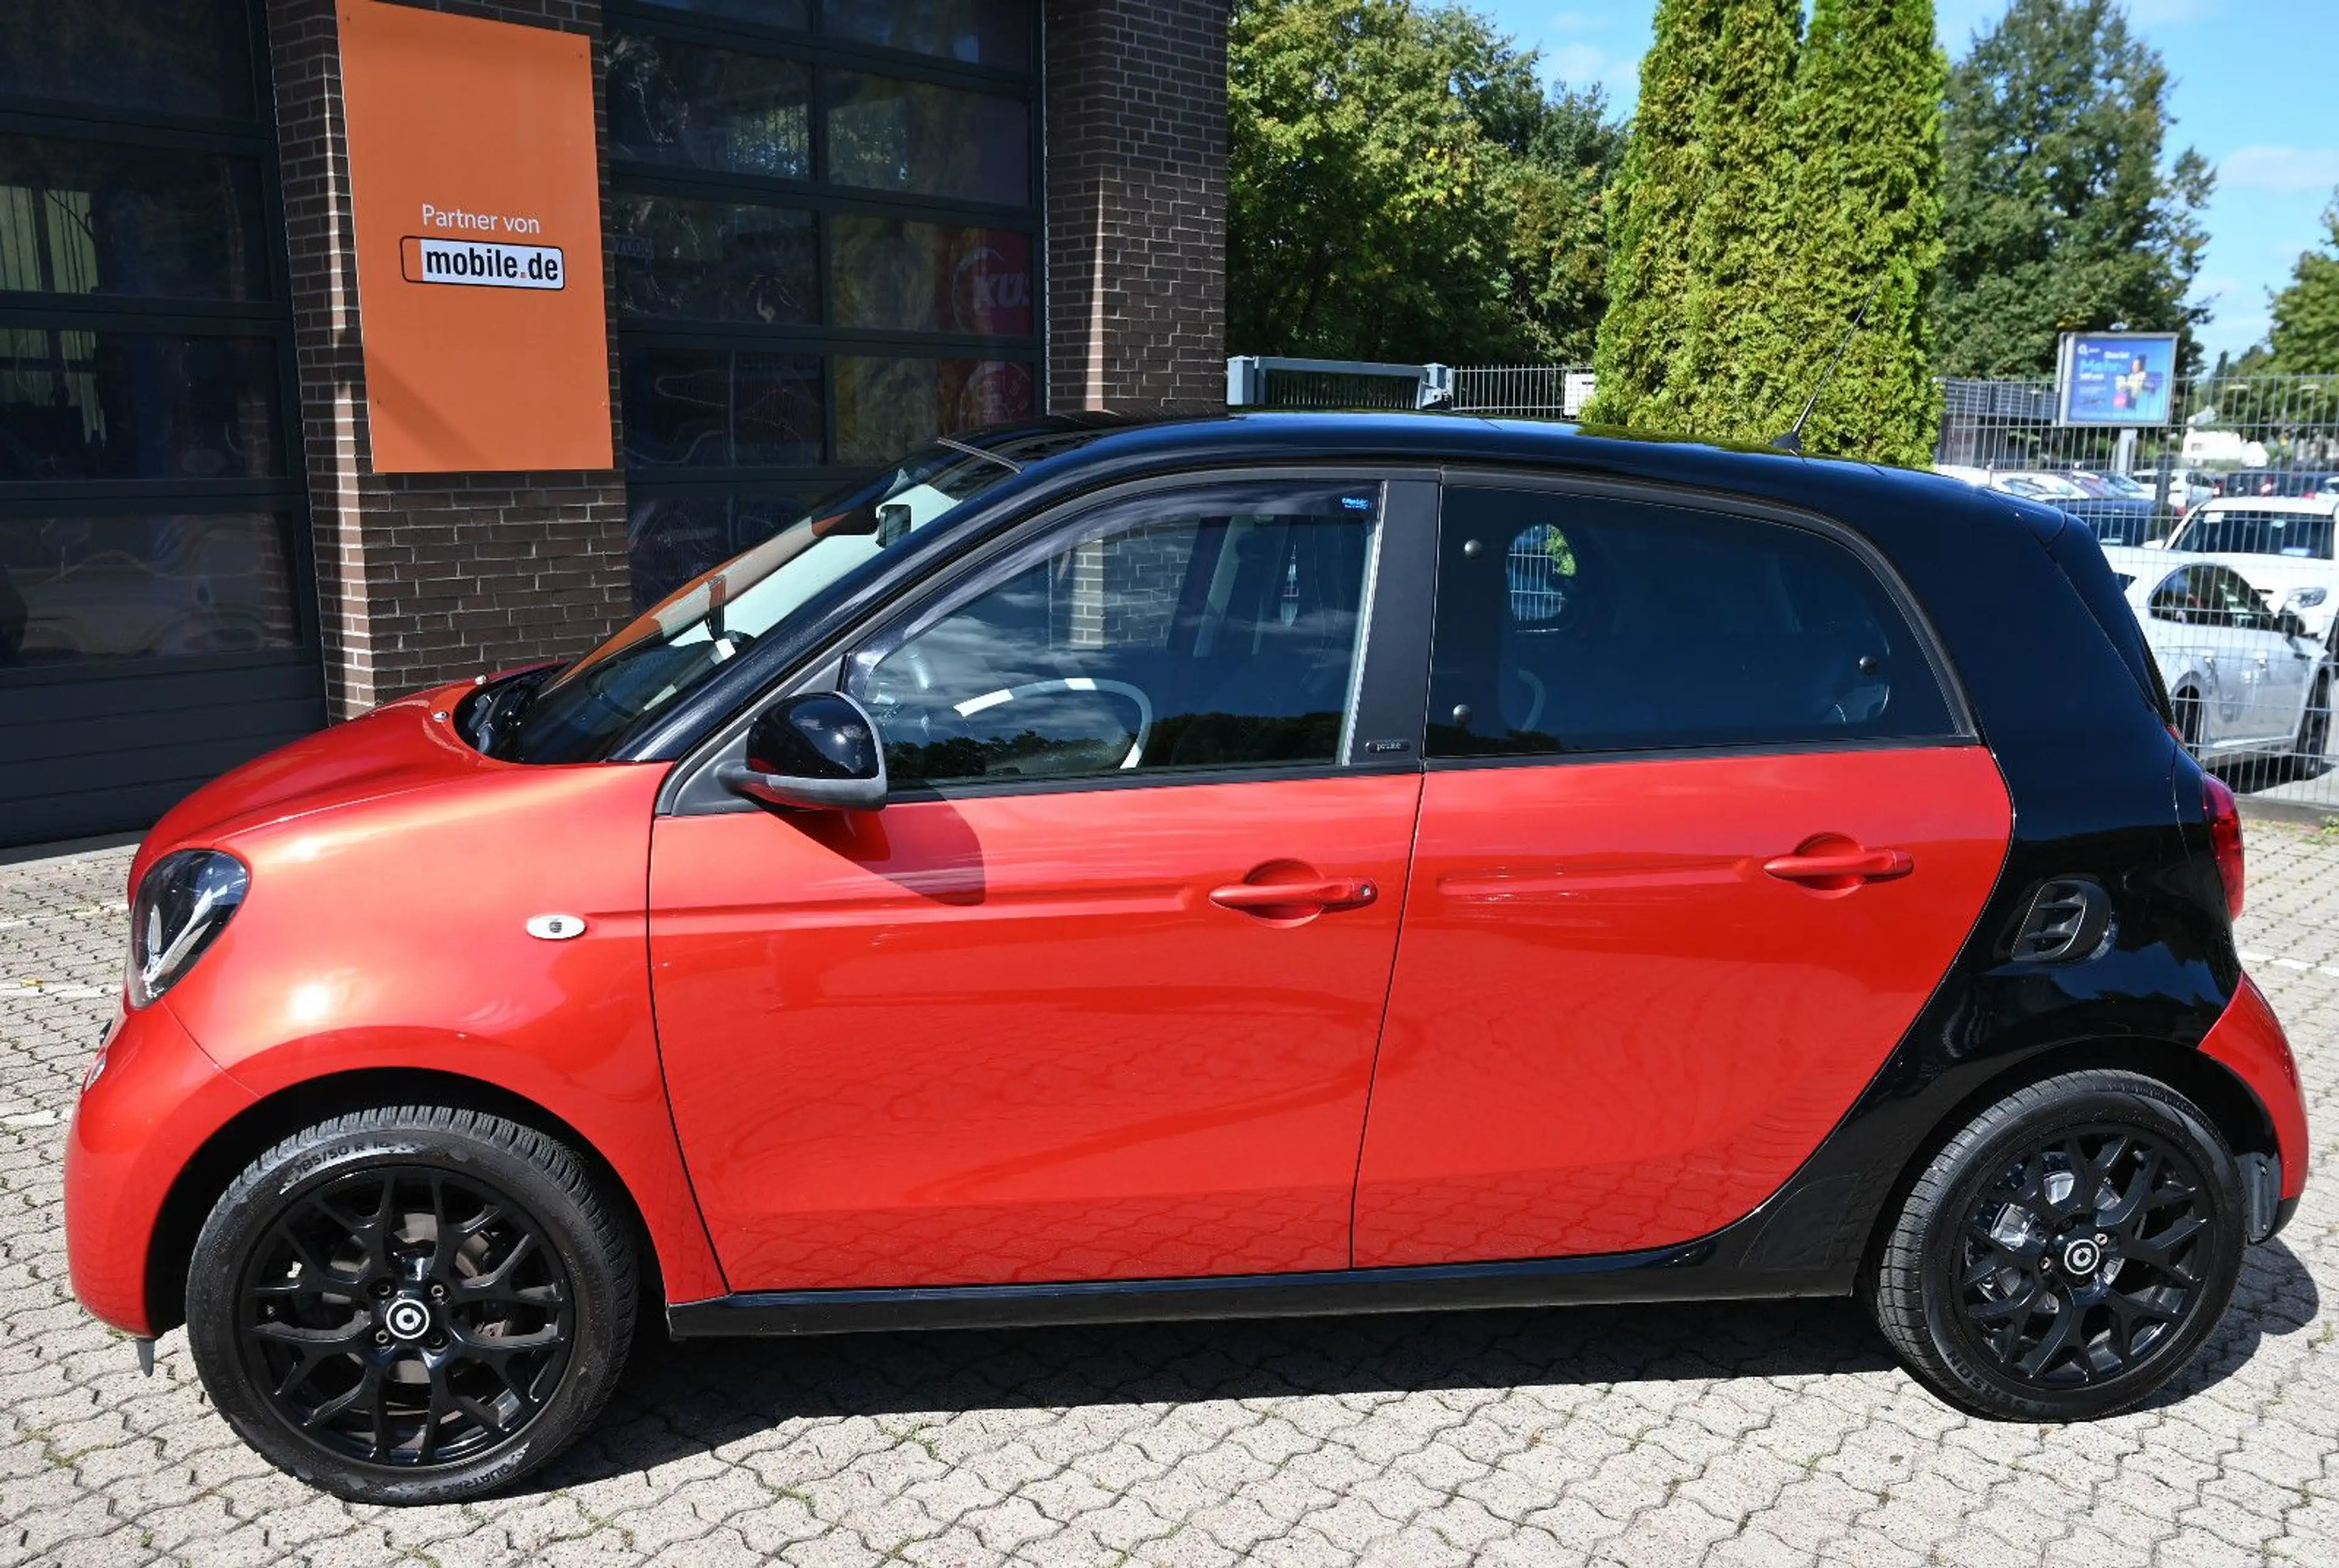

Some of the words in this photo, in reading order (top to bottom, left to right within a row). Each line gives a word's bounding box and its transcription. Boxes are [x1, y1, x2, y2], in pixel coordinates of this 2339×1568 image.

[422, 203, 498, 231] Partner
[503, 217, 541, 234] von
[426, 247, 559, 281] mobile.de
[355, 1142, 365, 1153] R
